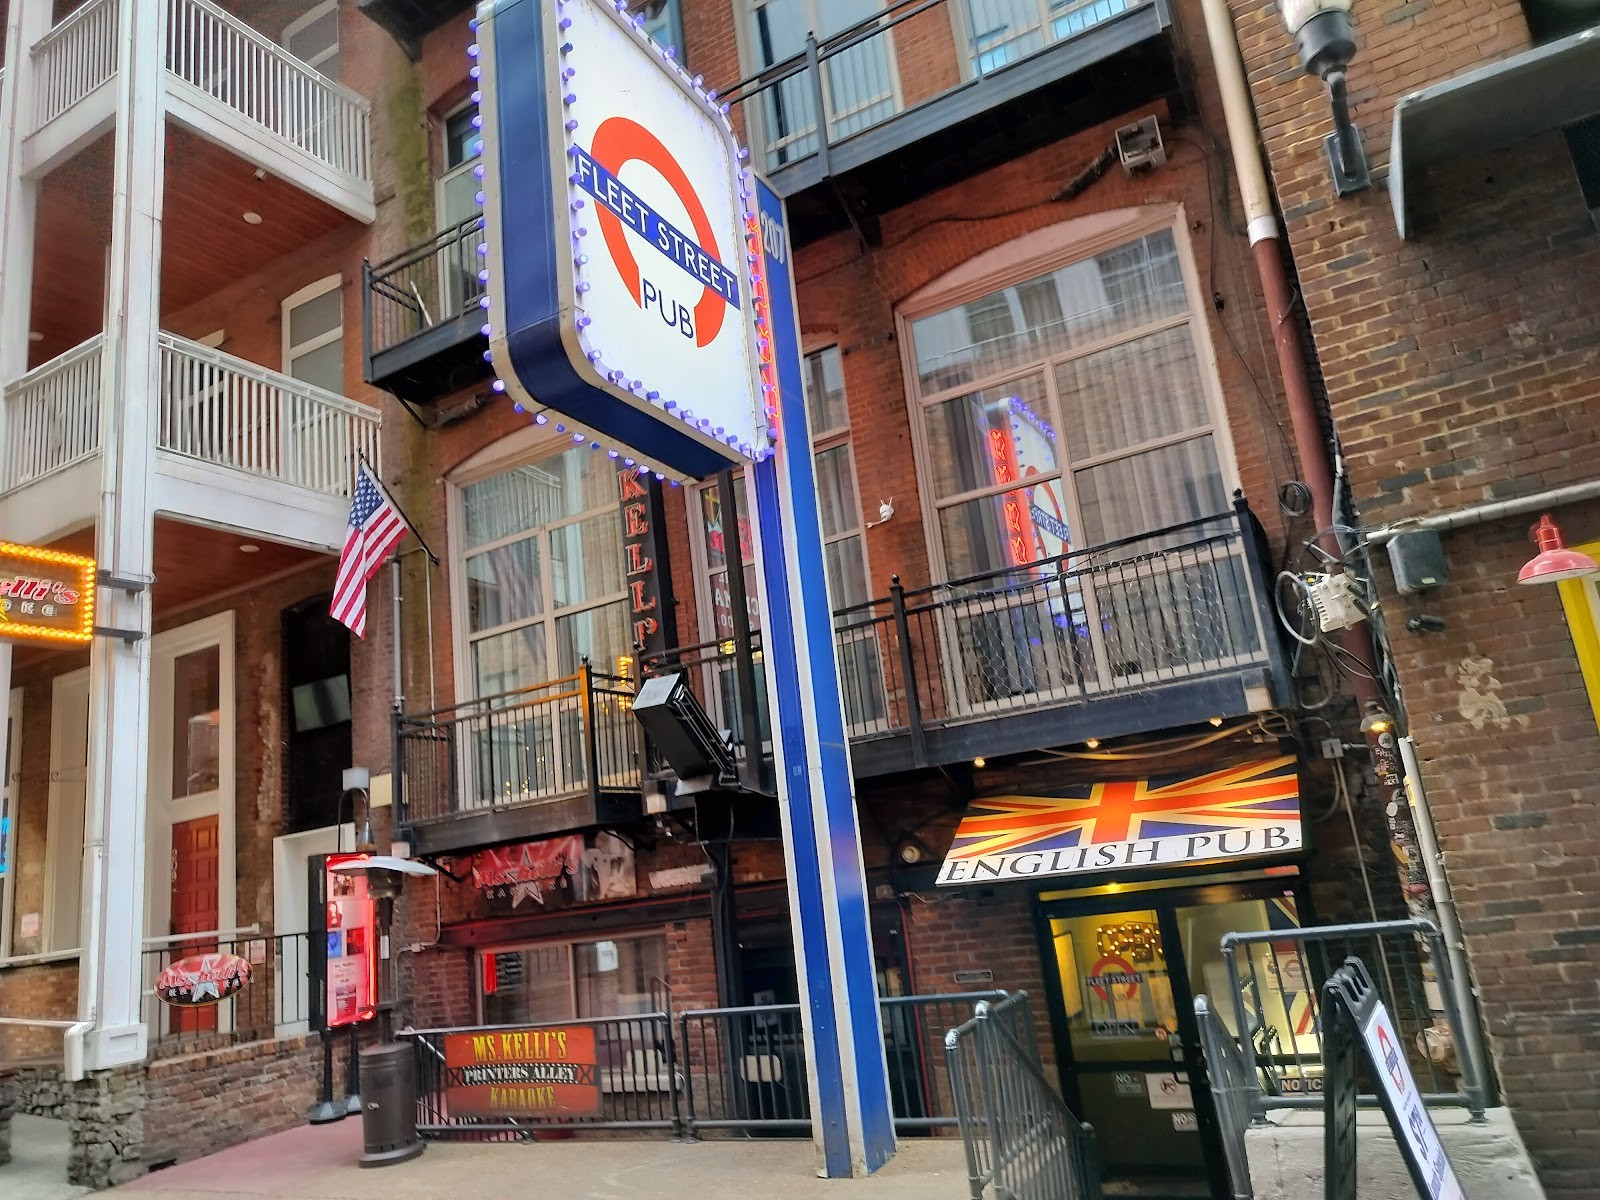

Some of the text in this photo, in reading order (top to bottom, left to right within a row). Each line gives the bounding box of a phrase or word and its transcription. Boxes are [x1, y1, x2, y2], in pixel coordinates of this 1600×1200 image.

[577, 153, 734, 299] FLEET STREET
[760, 208, 786, 265] 207
[641, 276, 694, 339] PUB
[946, 825, 1291, 882] ENGLISH PUB
[464, 1065, 577, 1082] PRINTERS ALLEY
[489, 1085, 557, 1110] KARAOKE
